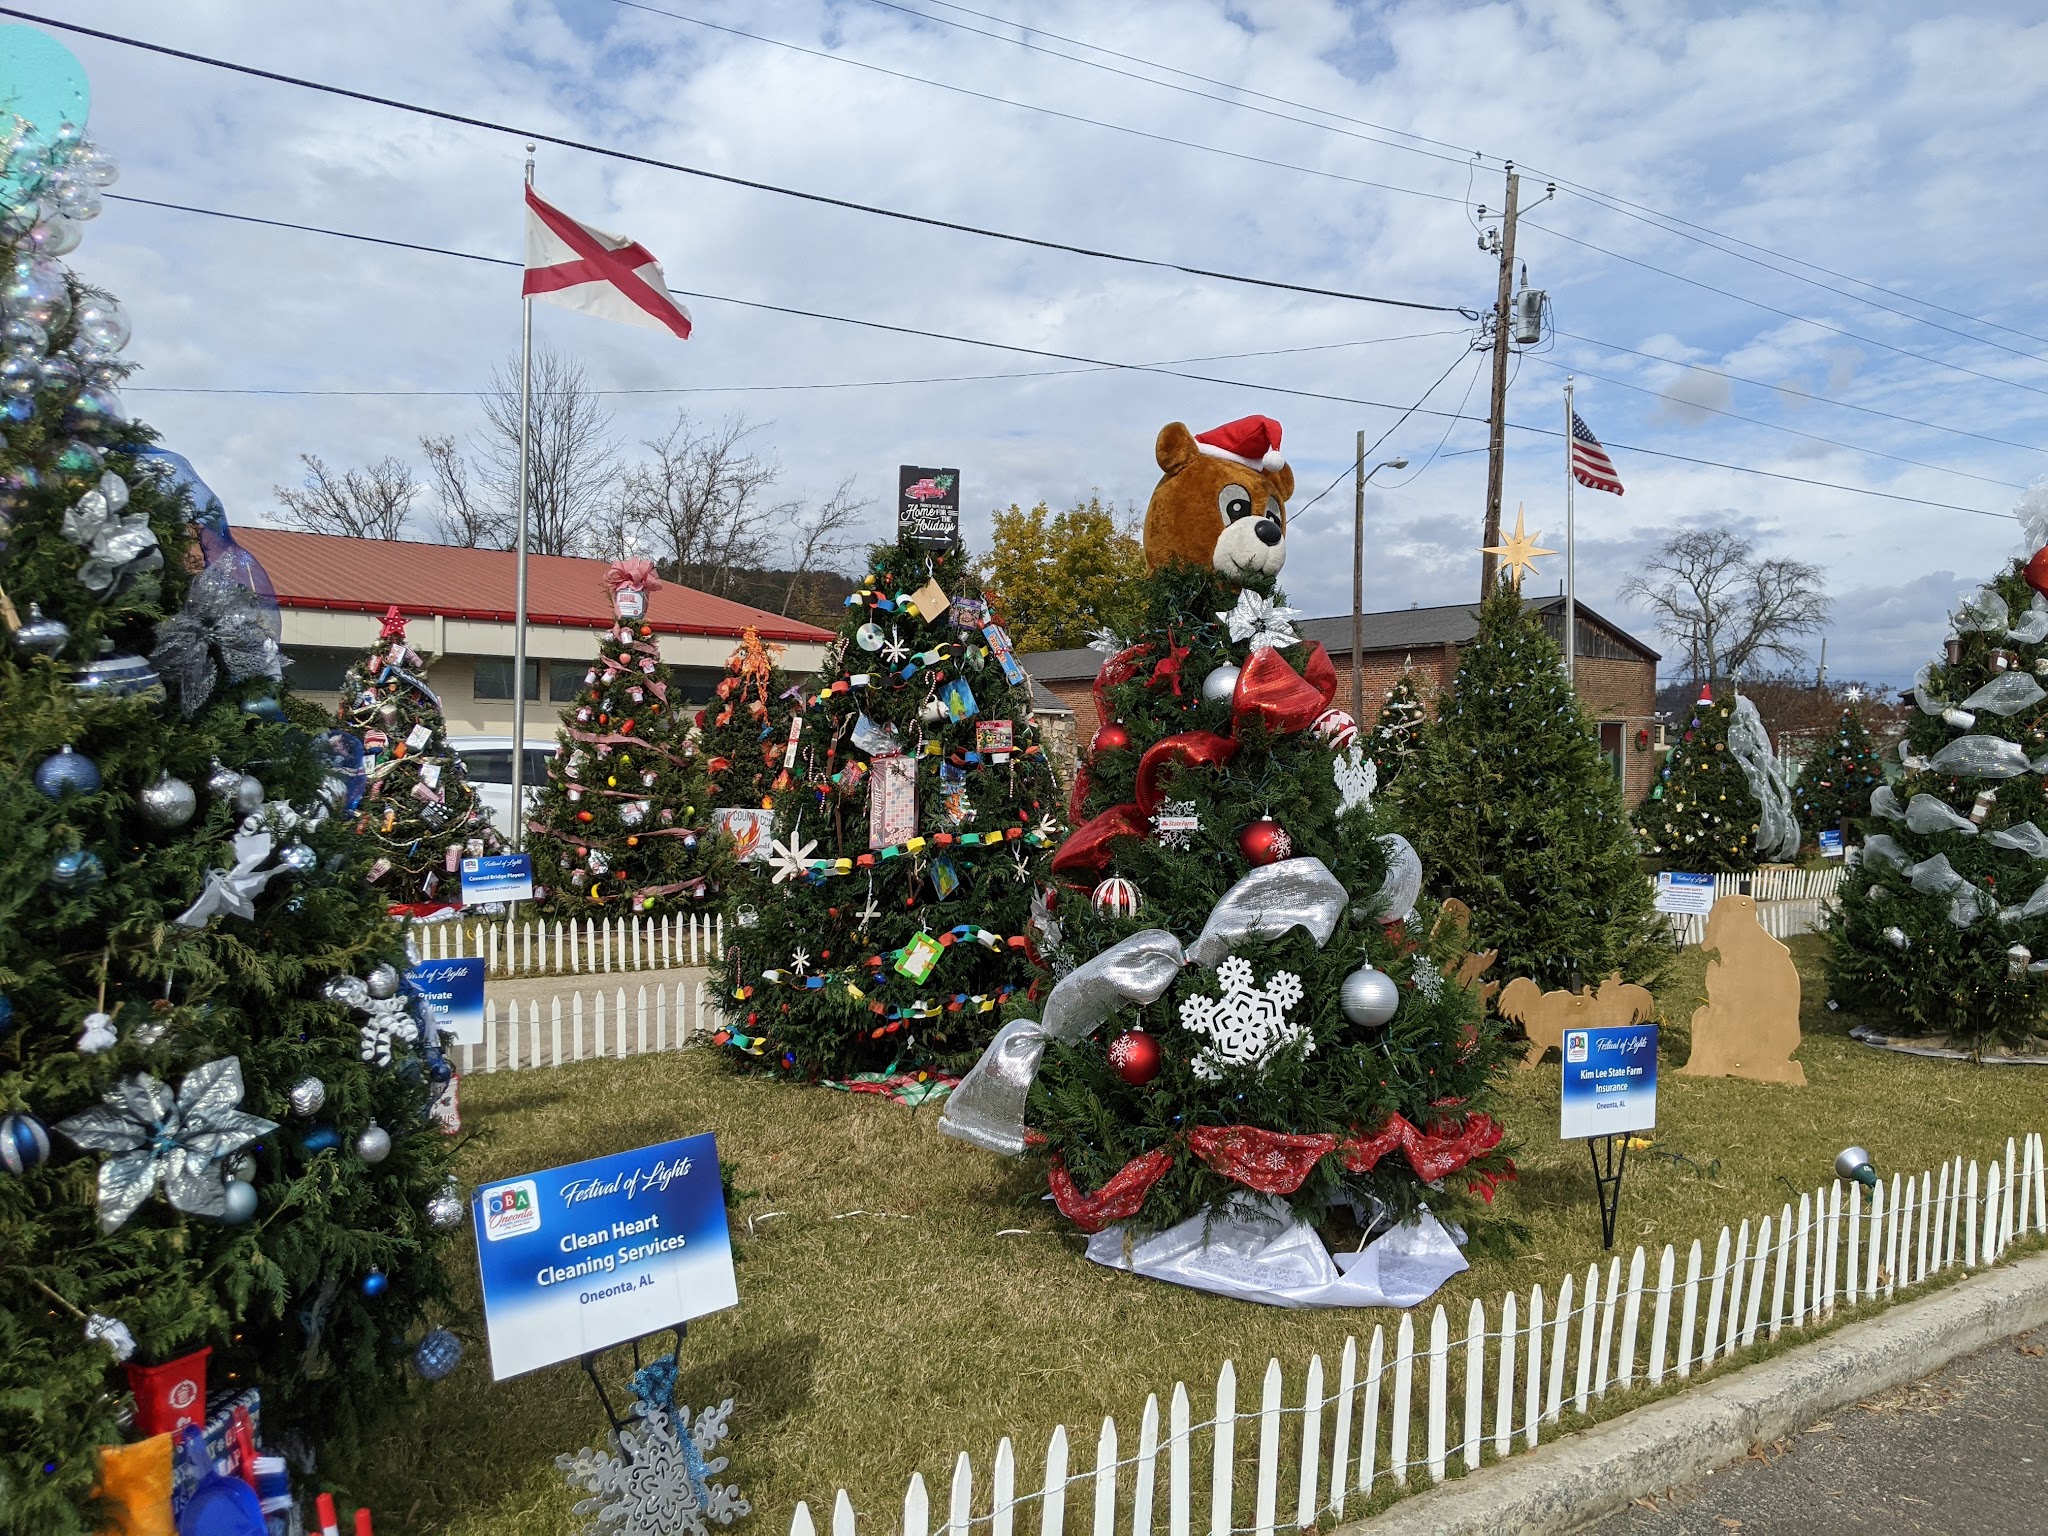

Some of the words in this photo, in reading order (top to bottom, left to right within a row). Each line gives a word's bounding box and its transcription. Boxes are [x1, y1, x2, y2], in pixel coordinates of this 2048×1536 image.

[900, 504, 936, 520] Home
[909, 518, 956, 534] Holidays
[989, 634, 1007, 663] TROULE
[872, 781, 884, 829] SCRABBLE
[484, 860, 502, 868] Festival
[502, 860, 507, 868] of
[507, 858, 522, 867] Lights
[404, 968, 428, 980] tival
[426, 968, 438, 983] of
[437, 967, 470, 982] Lights
[418, 992, 452, 1000] Private
[430, 1004, 449, 1014] ling
[1596, 1038, 1620, 1053] Festival
[1620, 1038, 1628, 1055] of
[1627, 1036, 1648, 1054] Lights
[1580, 1069, 1594, 1079] Kim
[1595, 1068, 1607, 1078] Lee
[1608, 1068, 1625, 1077] State
[1626, 1066, 1642, 1075] Farm
[1596, 1083, 1628, 1093] Insurance
[1596, 1101, 1618, 1110] Oneonta,
[491, 1194, 528, 1212] OBA
[560, 1172, 620, 1209] Festival
[623, 1168, 640, 1200] of
[640, 1156, 695, 1191] Lights
[489, 1206, 534, 1230] Oneonta
[560, 1227, 609, 1254] Clean
[612, 1213, 659, 1239] Heart
[536, 1249, 615, 1287] Cleaning
[618, 1234, 686, 1265] Services
[580, 1279, 637, 1305] Oneonta,
[639, 1273, 655, 1287] AL
